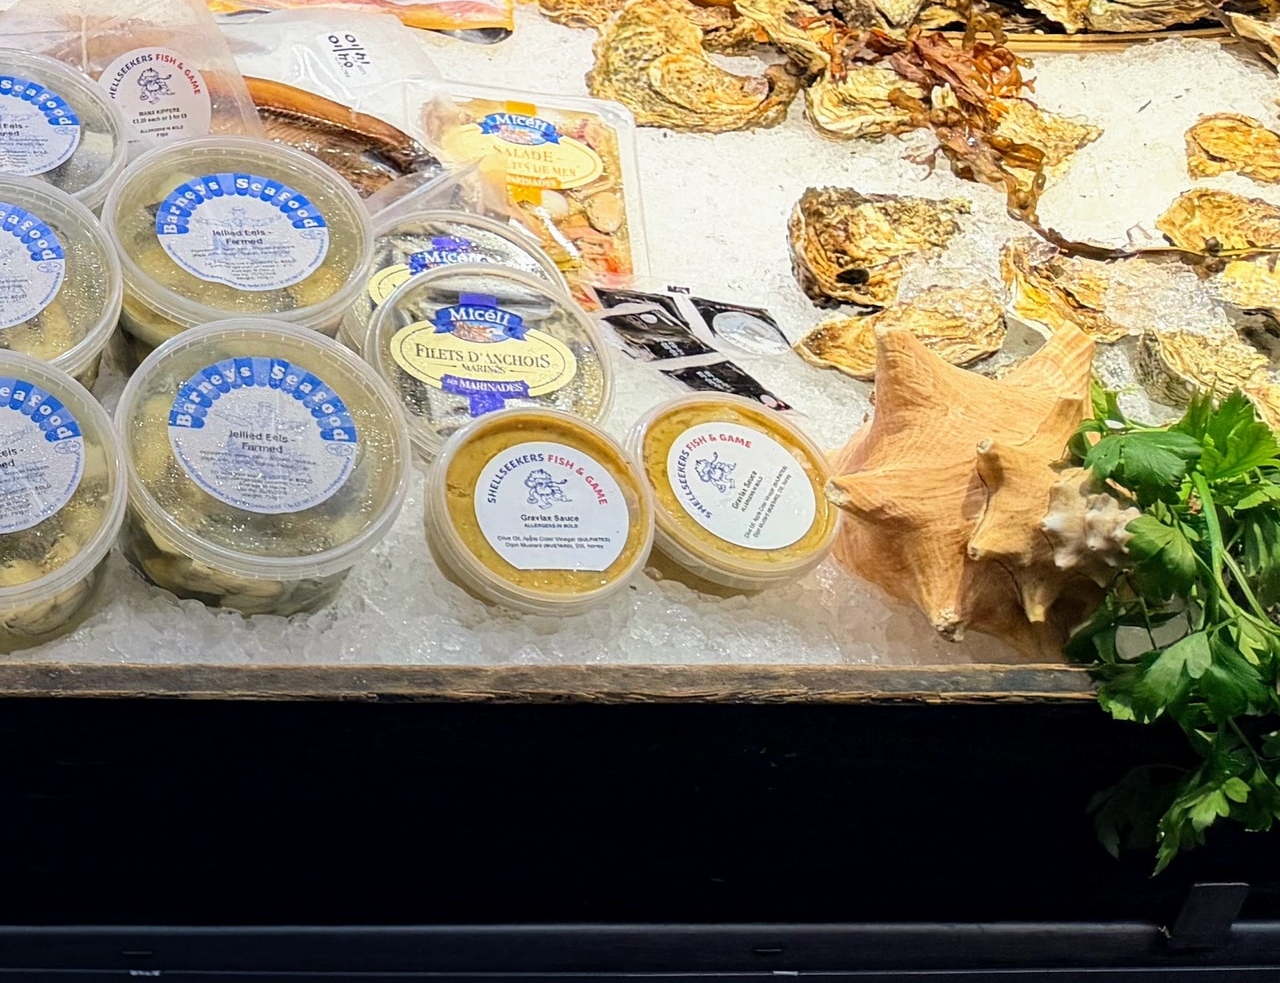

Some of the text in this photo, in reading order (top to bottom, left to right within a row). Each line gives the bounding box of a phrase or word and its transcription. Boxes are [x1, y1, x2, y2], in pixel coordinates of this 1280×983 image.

[109, 53, 201, 99] HELLSEEKERS FISH & GAME
[0, 79, 74, 126] Seafood
[3, 122, 24, 130] Eels
[493, 144, 554, 163] SALADE
[533, 164, 576, 177] DE MER
[163, 178, 319, 234] Barneys Seafood
[212, 228, 243, 237] Jellied
[226, 237, 263, 245] Farmed
[449, 308, 511, 325] Micéli
[415, 343, 551, 368] FILETS D'ANCHOIS
[460, 379, 524, 393] MARINADES
[175, 365, 350, 441] Barneys Seafood
[228, 429, 289, 443] Jellied Eels
[241, 443, 283, 454] Farmed
[487, 452, 609, 506] SHELLSEEKERS FISH & GAME
[671, 433, 752, 520] SHELLSEEKERS FISH & GAME
[743, 470, 758, 489] Sauce
[520, 513, 579, 522] Gravlax Sauce
